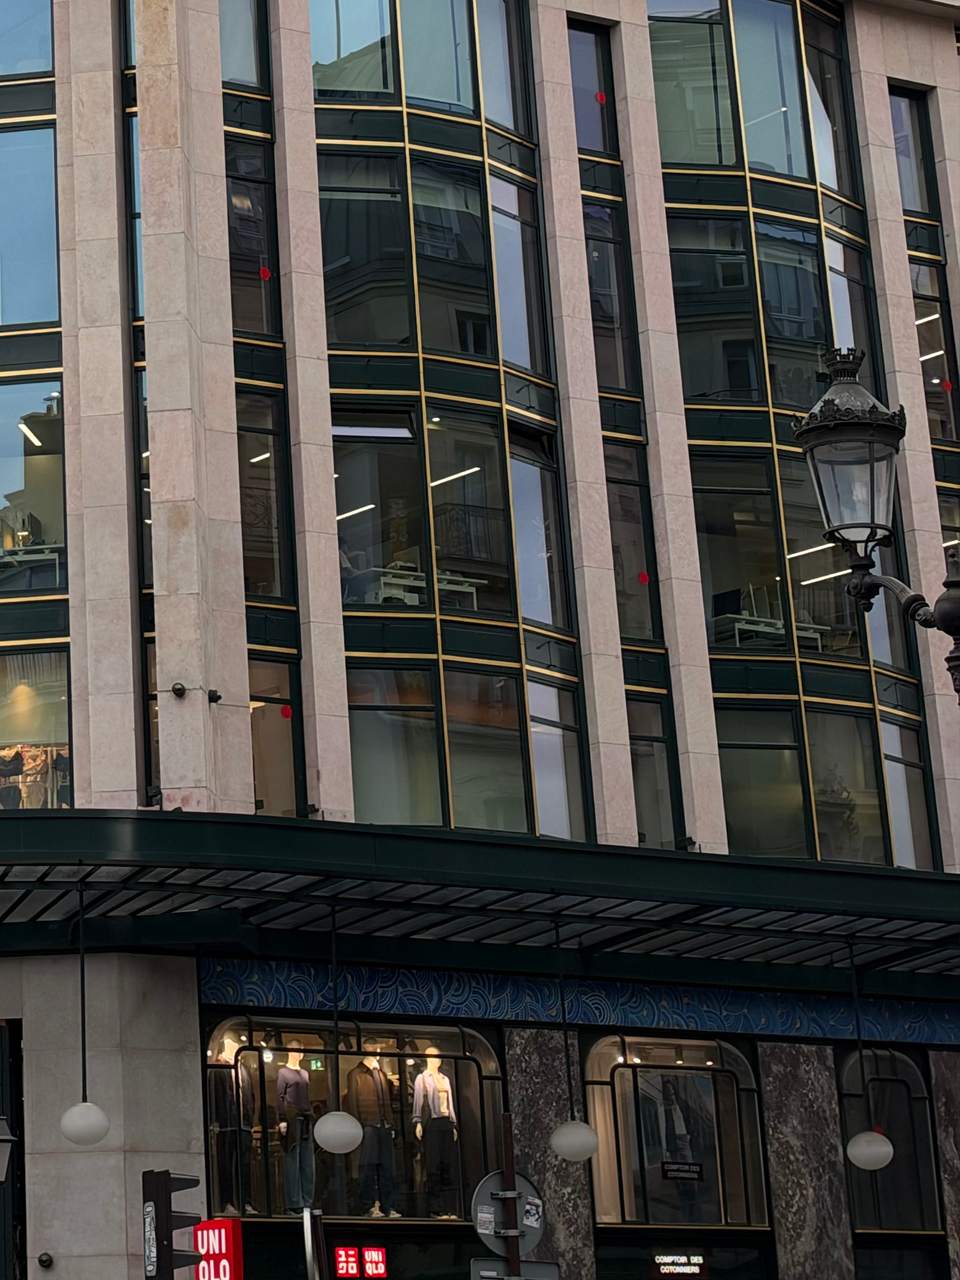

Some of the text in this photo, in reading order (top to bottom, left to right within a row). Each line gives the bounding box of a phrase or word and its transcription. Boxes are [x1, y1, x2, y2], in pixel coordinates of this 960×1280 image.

[197, 1228, 227, 1255] UNI
[338, 1250, 356, 1262] ユニ
[364, 1250, 383, 1262] UNI
[655, 1255, 703, 1264] COMPTOIR DES
[338, 1262, 357, 1274] クロ
[365, 1262, 385, 1276] QLO
